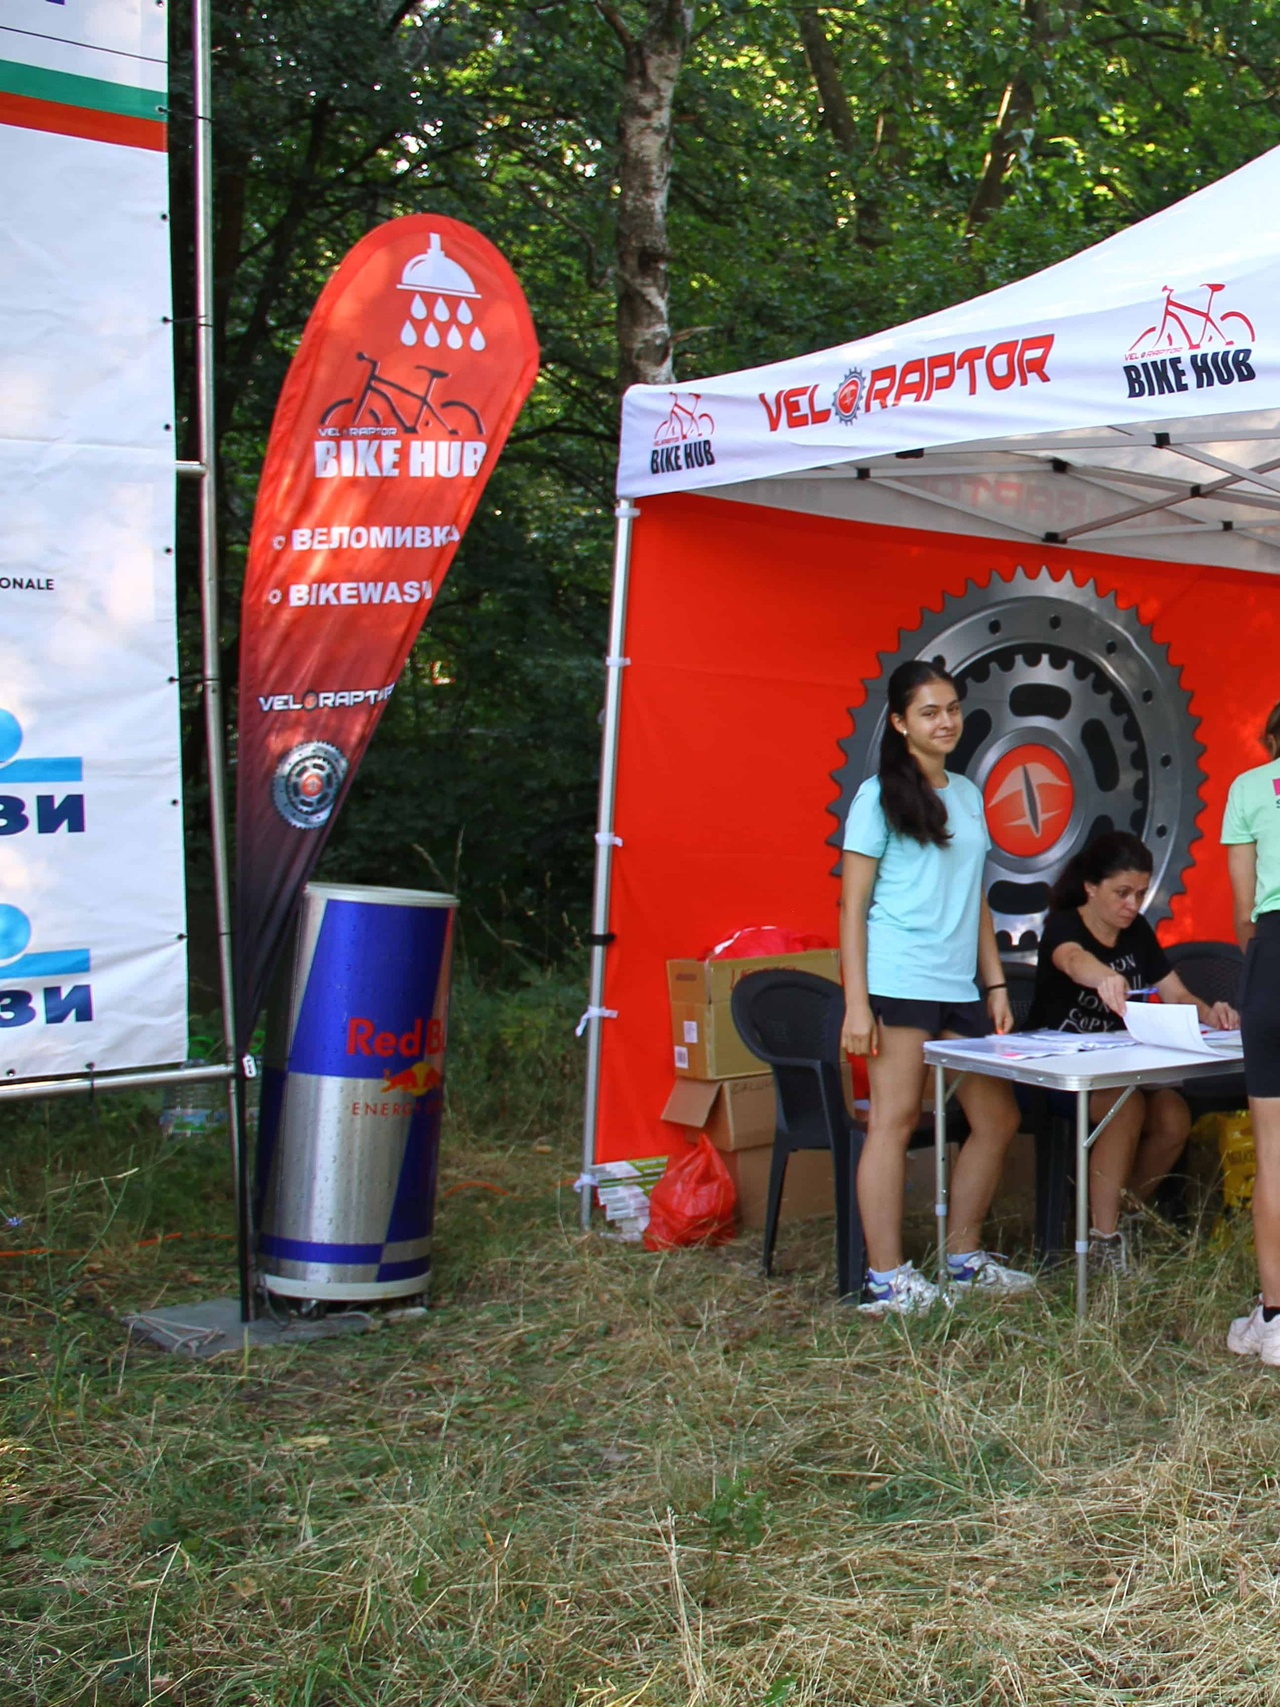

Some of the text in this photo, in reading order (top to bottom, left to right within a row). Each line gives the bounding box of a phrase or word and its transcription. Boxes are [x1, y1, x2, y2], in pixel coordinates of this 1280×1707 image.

[1122, 347, 1257, 399] BIKE HUB
[314, 439, 488, 478] BIKE HUB
[651, 439, 715, 474] BIKE HUB
[346, 1017, 423, 1057] Red
